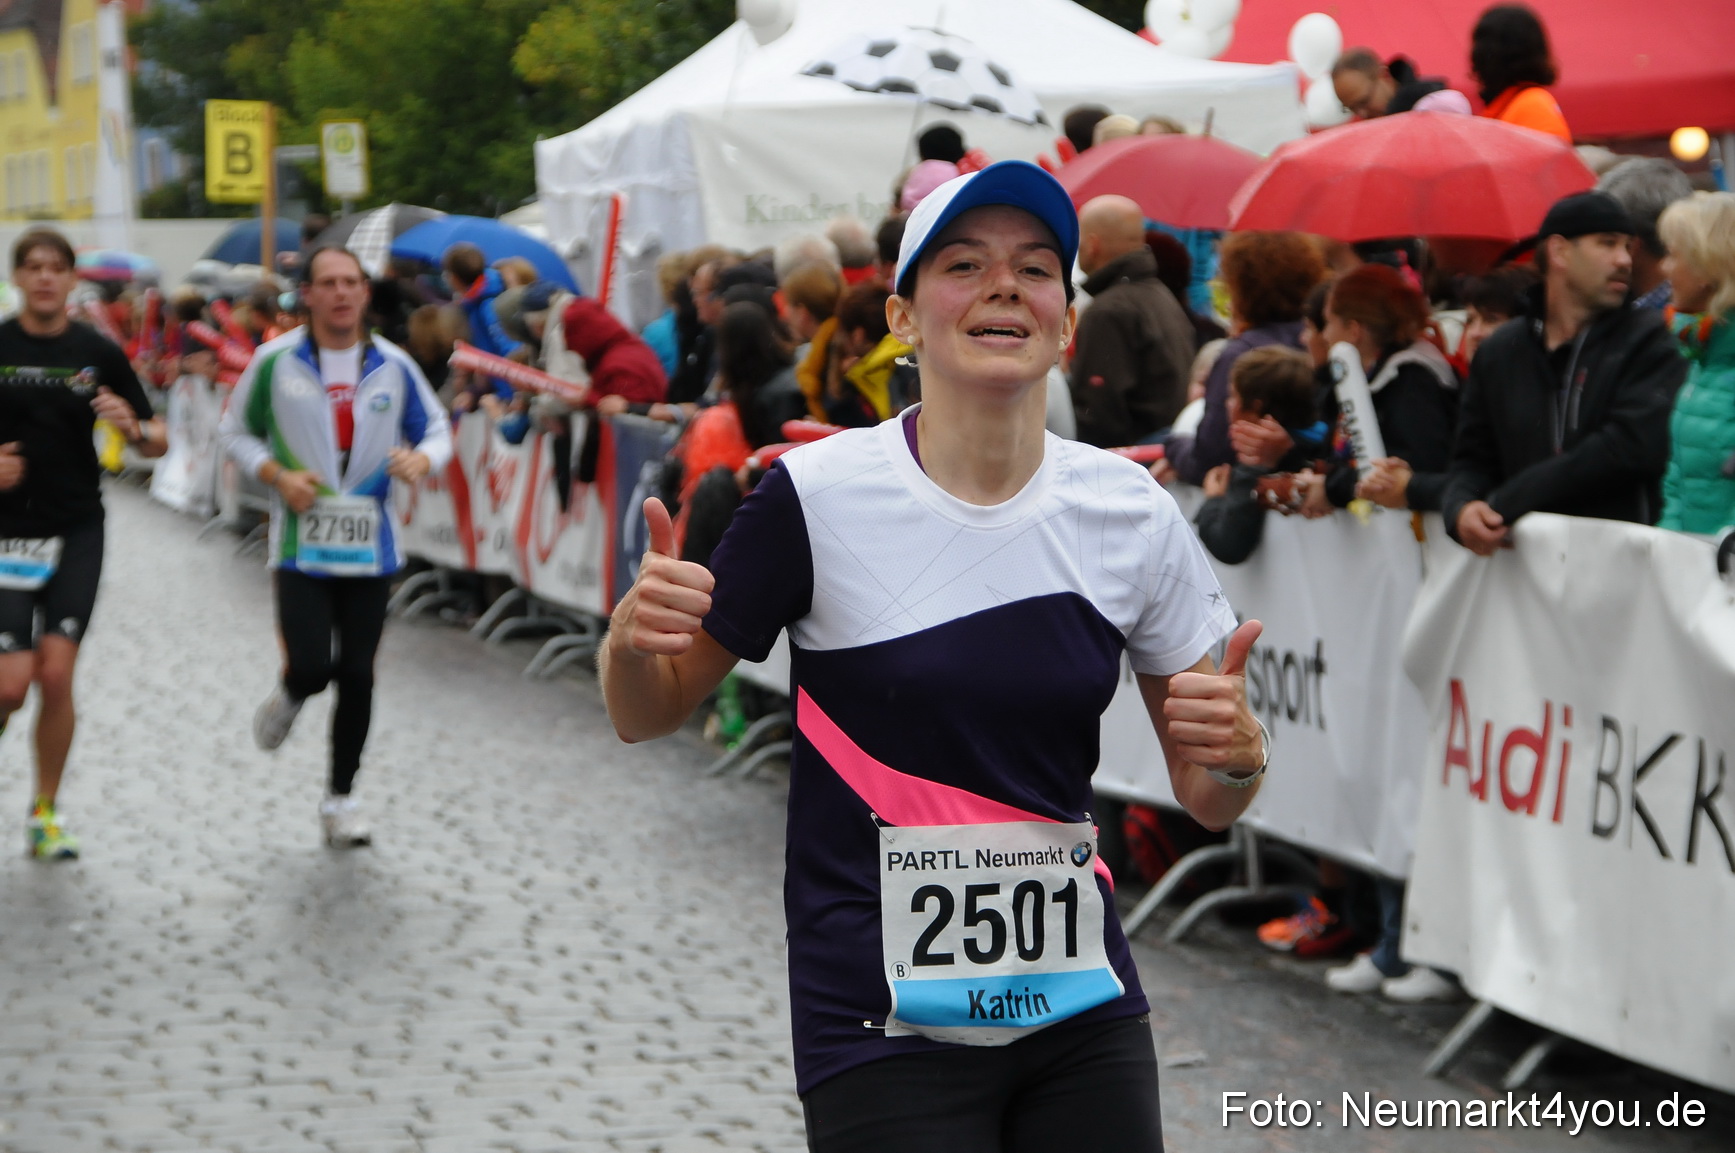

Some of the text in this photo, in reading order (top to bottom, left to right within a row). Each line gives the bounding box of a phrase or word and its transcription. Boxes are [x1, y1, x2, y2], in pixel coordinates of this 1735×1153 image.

[226, 131, 252, 175] B
[306, 514, 369, 542] 2790
[1591, 712, 1735, 876] BKK
[887, 846, 1065, 871] PARTL Neumarkt
[910, 877, 1078, 967] 2501
[895, 963, 905, 978] B
[968, 987, 1052, 1020] Katrin
